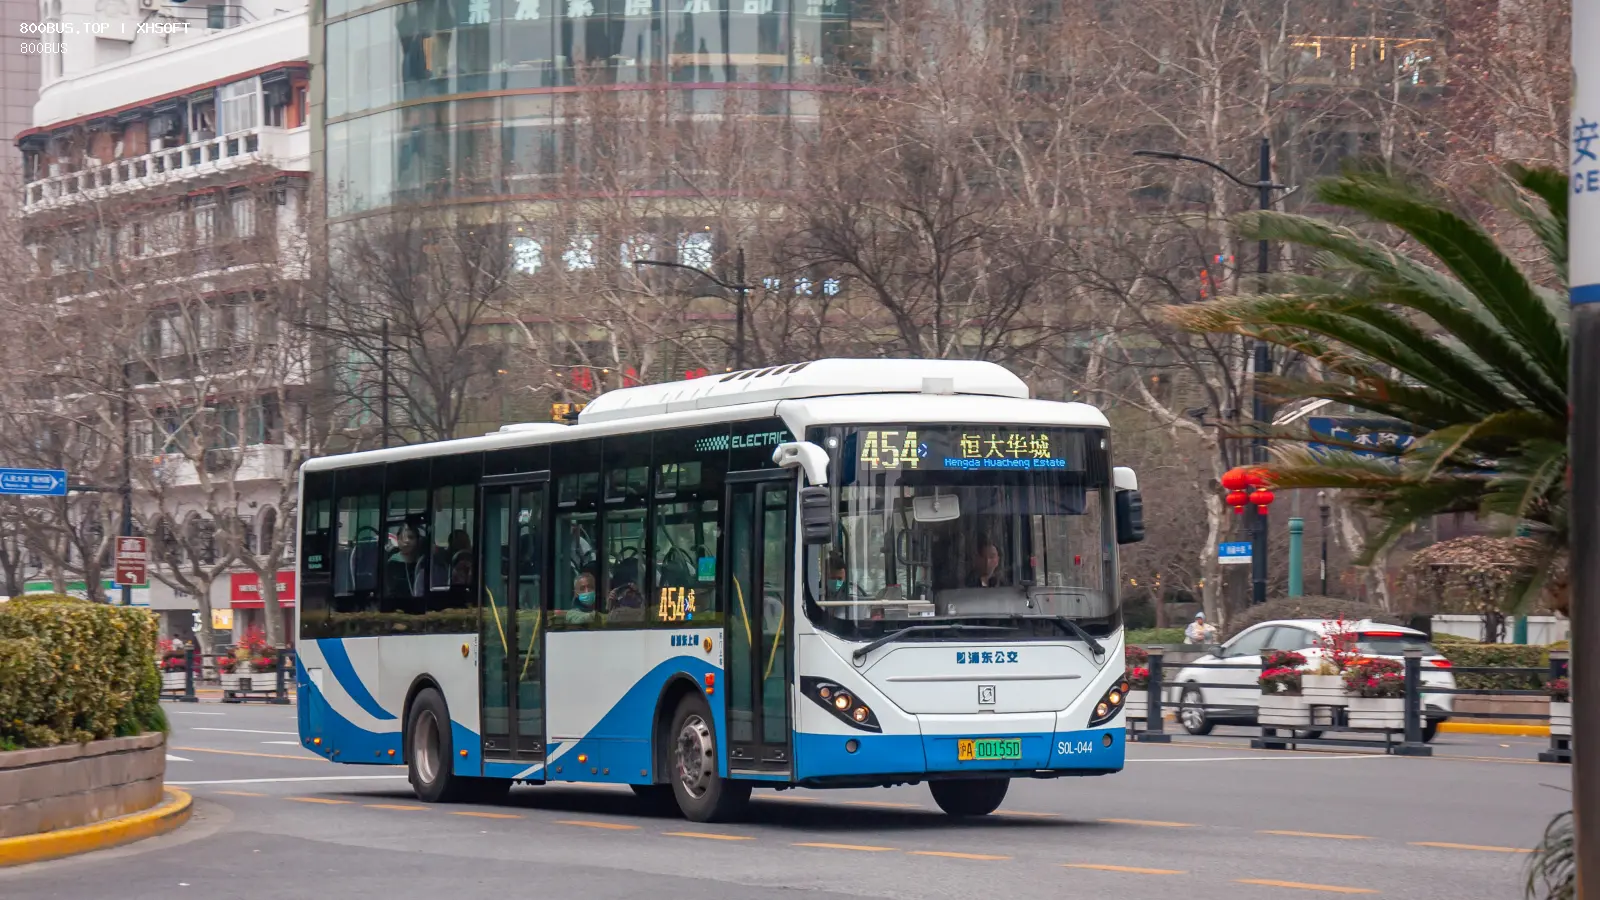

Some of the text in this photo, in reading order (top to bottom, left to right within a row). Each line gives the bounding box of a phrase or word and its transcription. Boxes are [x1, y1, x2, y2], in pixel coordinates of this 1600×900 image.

[1573, 116, 1599, 166] 安
[731, 430, 788, 449] ELECTRIC
[861, 431, 919, 469] 454
[960, 433, 1051, 458] 恒大华城
[944, 458, 1066, 470] Hengda Huacheng Estate
[659, 586, 685, 621] 454
[968, 651, 1018, 664] 浦东公交
